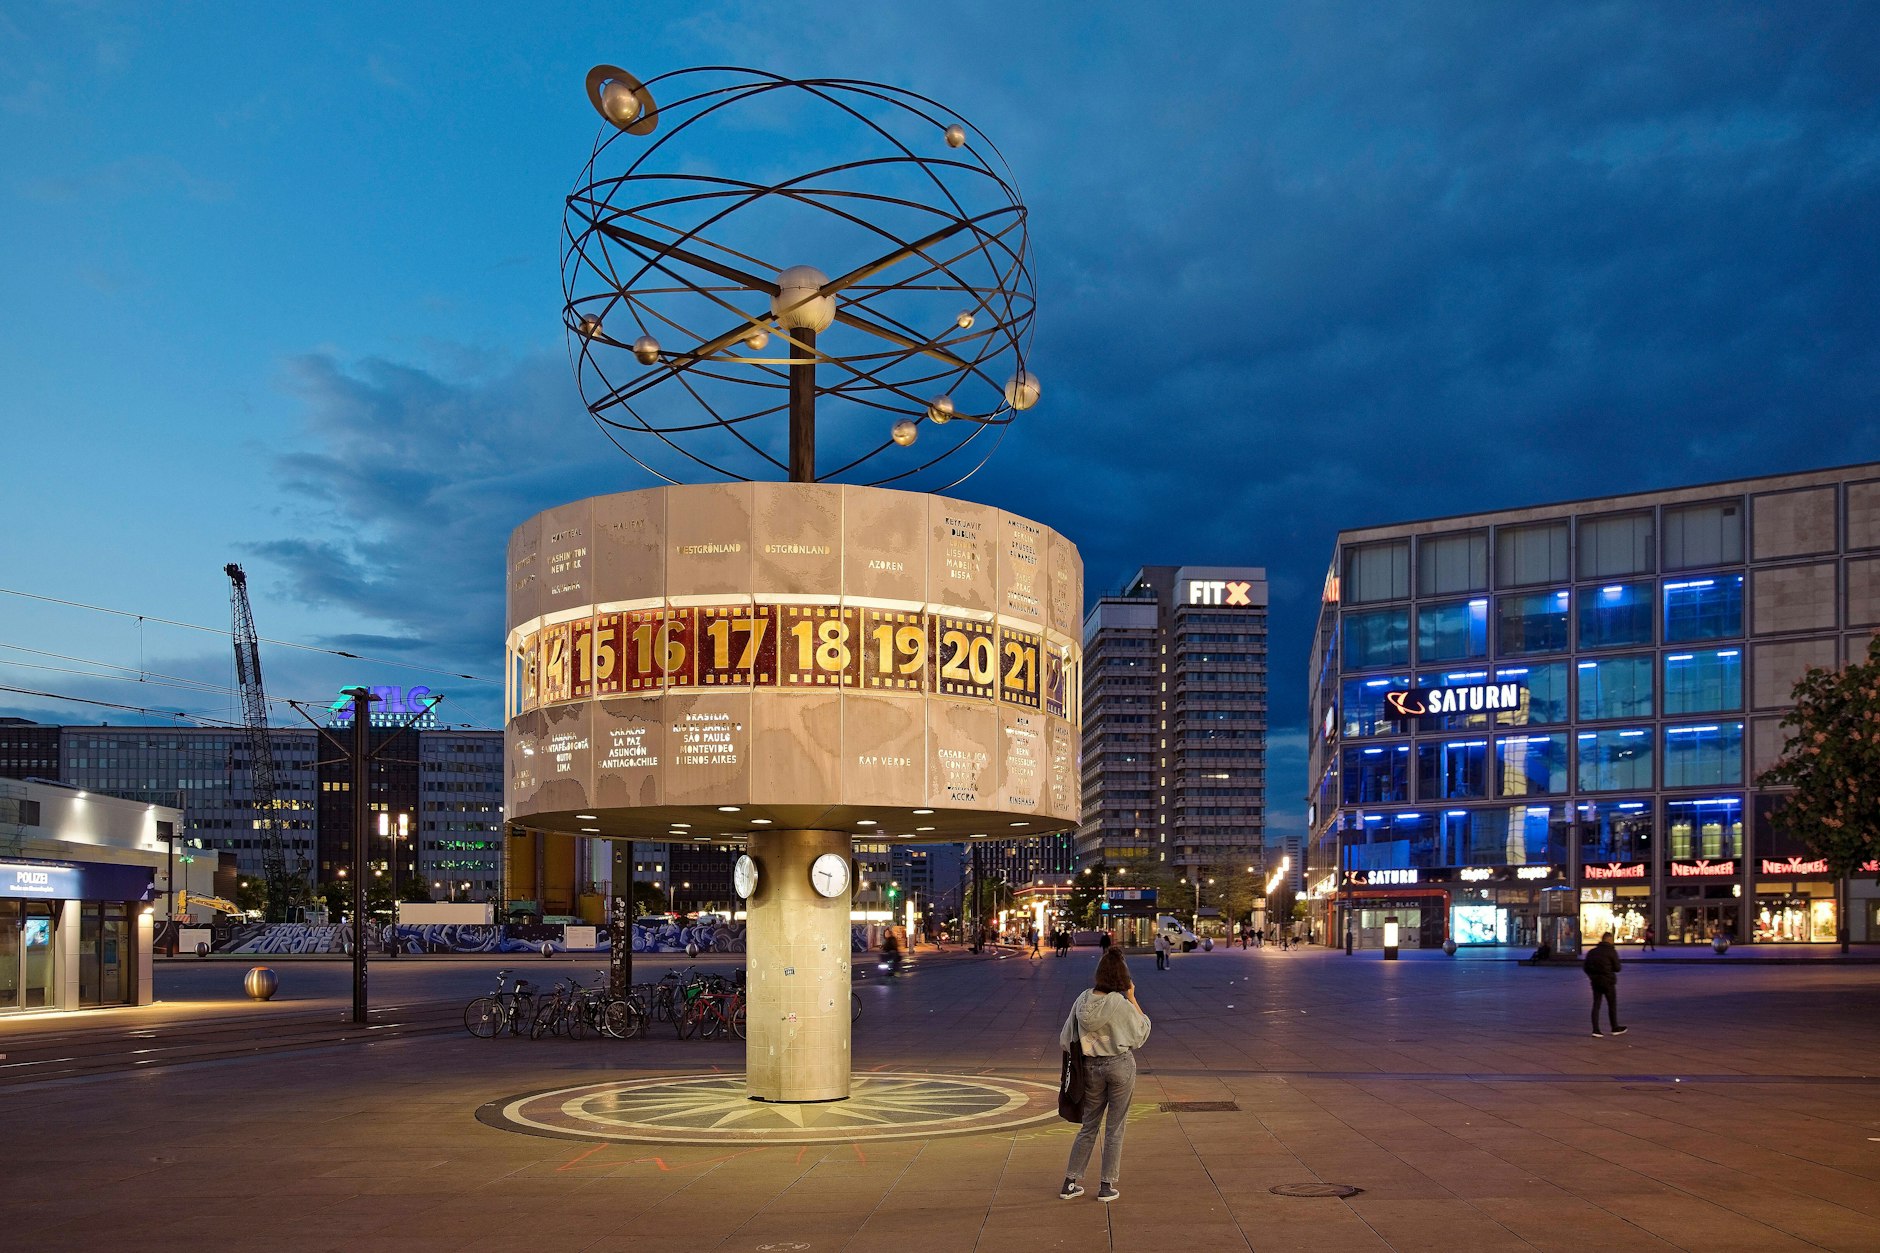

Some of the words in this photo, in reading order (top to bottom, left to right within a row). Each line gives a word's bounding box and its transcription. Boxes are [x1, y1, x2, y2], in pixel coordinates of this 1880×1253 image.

[951, 528, 976, 540] DUBLIN
[765, 543, 830, 555] OSTGRÖNLAND
[868, 560, 904, 571] AZOREN
[633, 621, 686, 673] 16
[707, 618, 769, 669] 17
[792, 620, 851, 671] 18
[576, 629, 616, 681] 15
[873, 625, 927, 675] 19
[942, 631, 995, 685] 20
[1004, 642, 1036, 693] 21
[1428, 683, 1517, 714] SATURN
[673, 724, 687, 733] RIO
[689, 724, 700, 732] DE
[613, 738, 625, 747] LA
[626, 736, 641, 746] PAZ
[684, 732, 700, 743] SÃO
[703, 732, 731, 743] PAULO
[609, 745, 647, 757] ASUNCIÓN
[680, 744, 734, 754] MONTEVIDEO
[711, 755, 737, 764] AIRES
[859, 756, 878, 765] KAP
[881, 756, 911, 766] VERDE
[556, 763, 571, 772] LIMA
[950, 793, 976, 801] ACCRA
[16, 871, 48, 884] POLIZEI
[1368, 869, 1418, 884] SATURN
[264, 926, 337, 938] JOURNEY
[231, 935, 333, 954] EUROPE
